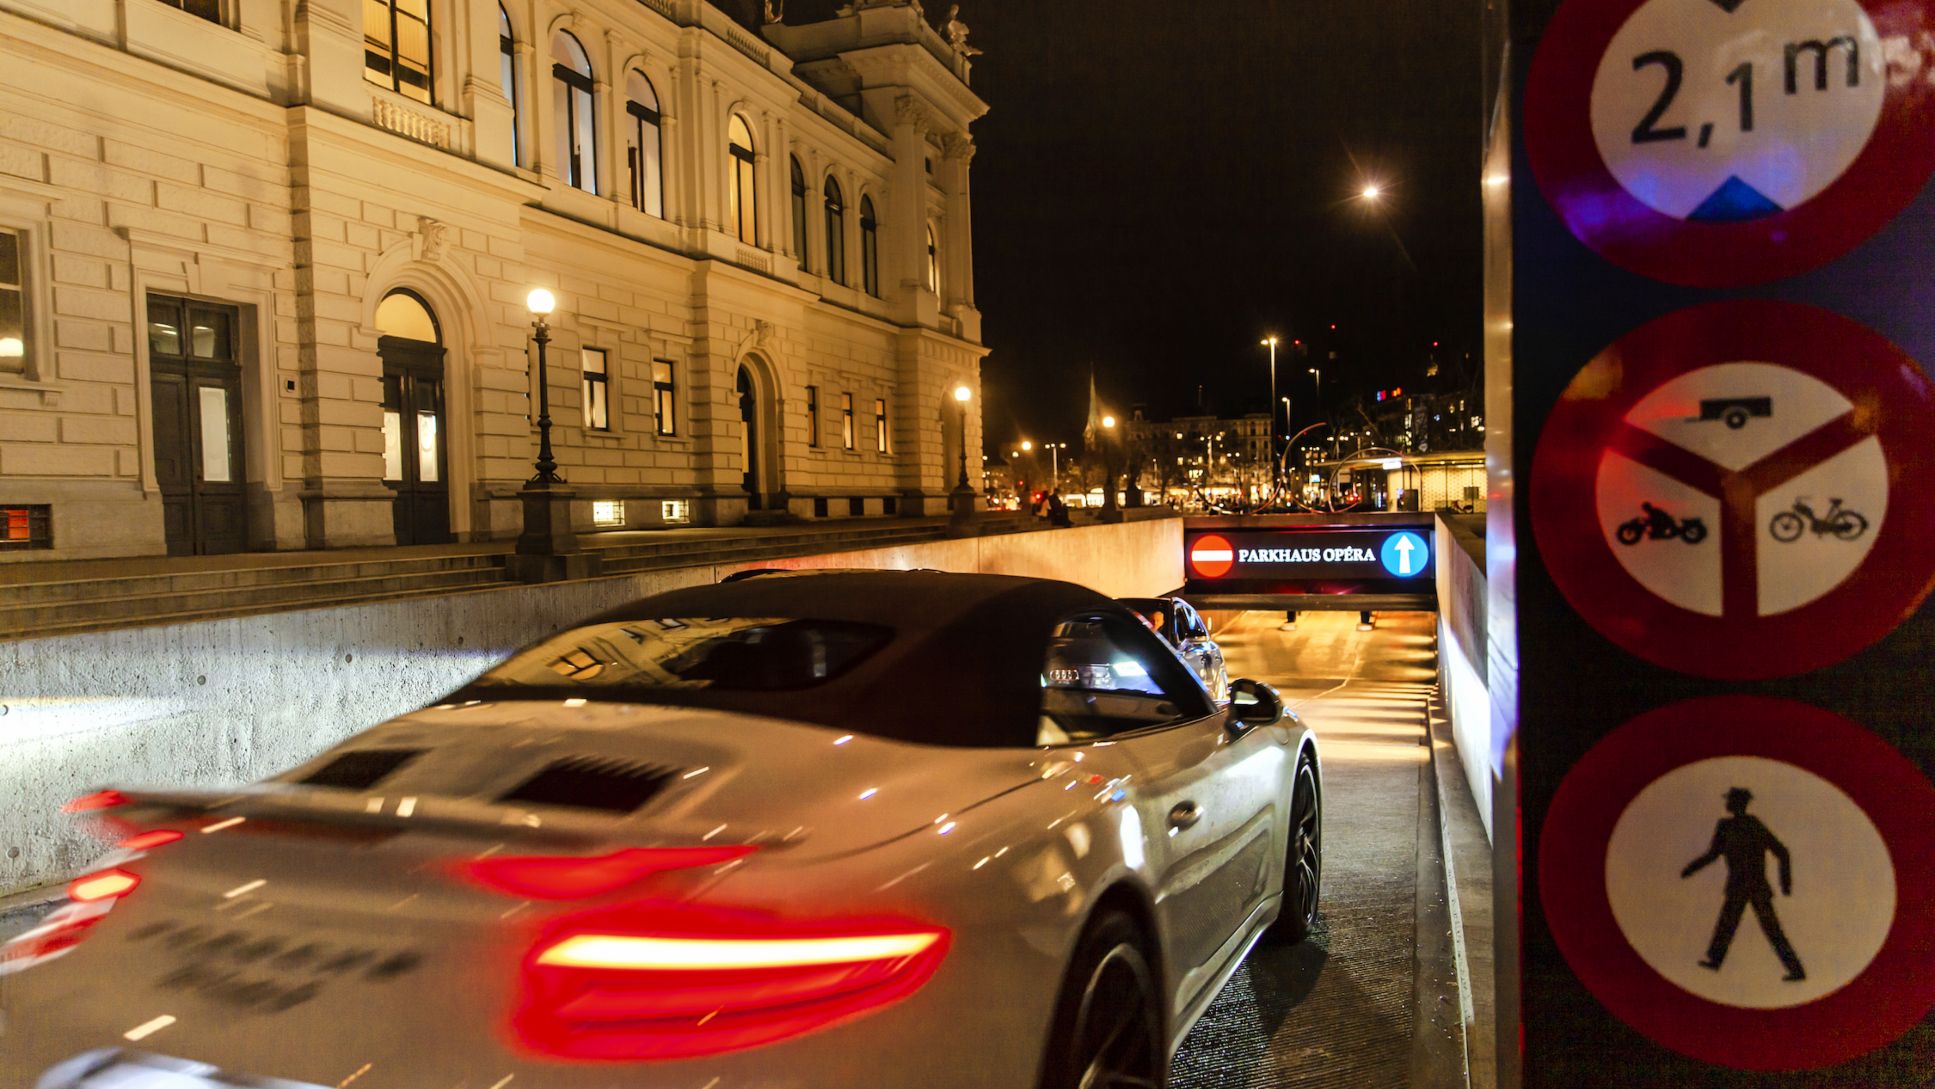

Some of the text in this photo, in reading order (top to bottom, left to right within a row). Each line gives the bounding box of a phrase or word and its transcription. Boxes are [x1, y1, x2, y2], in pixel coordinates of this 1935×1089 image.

[1630, 34, 1861, 149] 2,1 m
[1238, 545, 1377, 563] PARKHAUS OPÉRA
